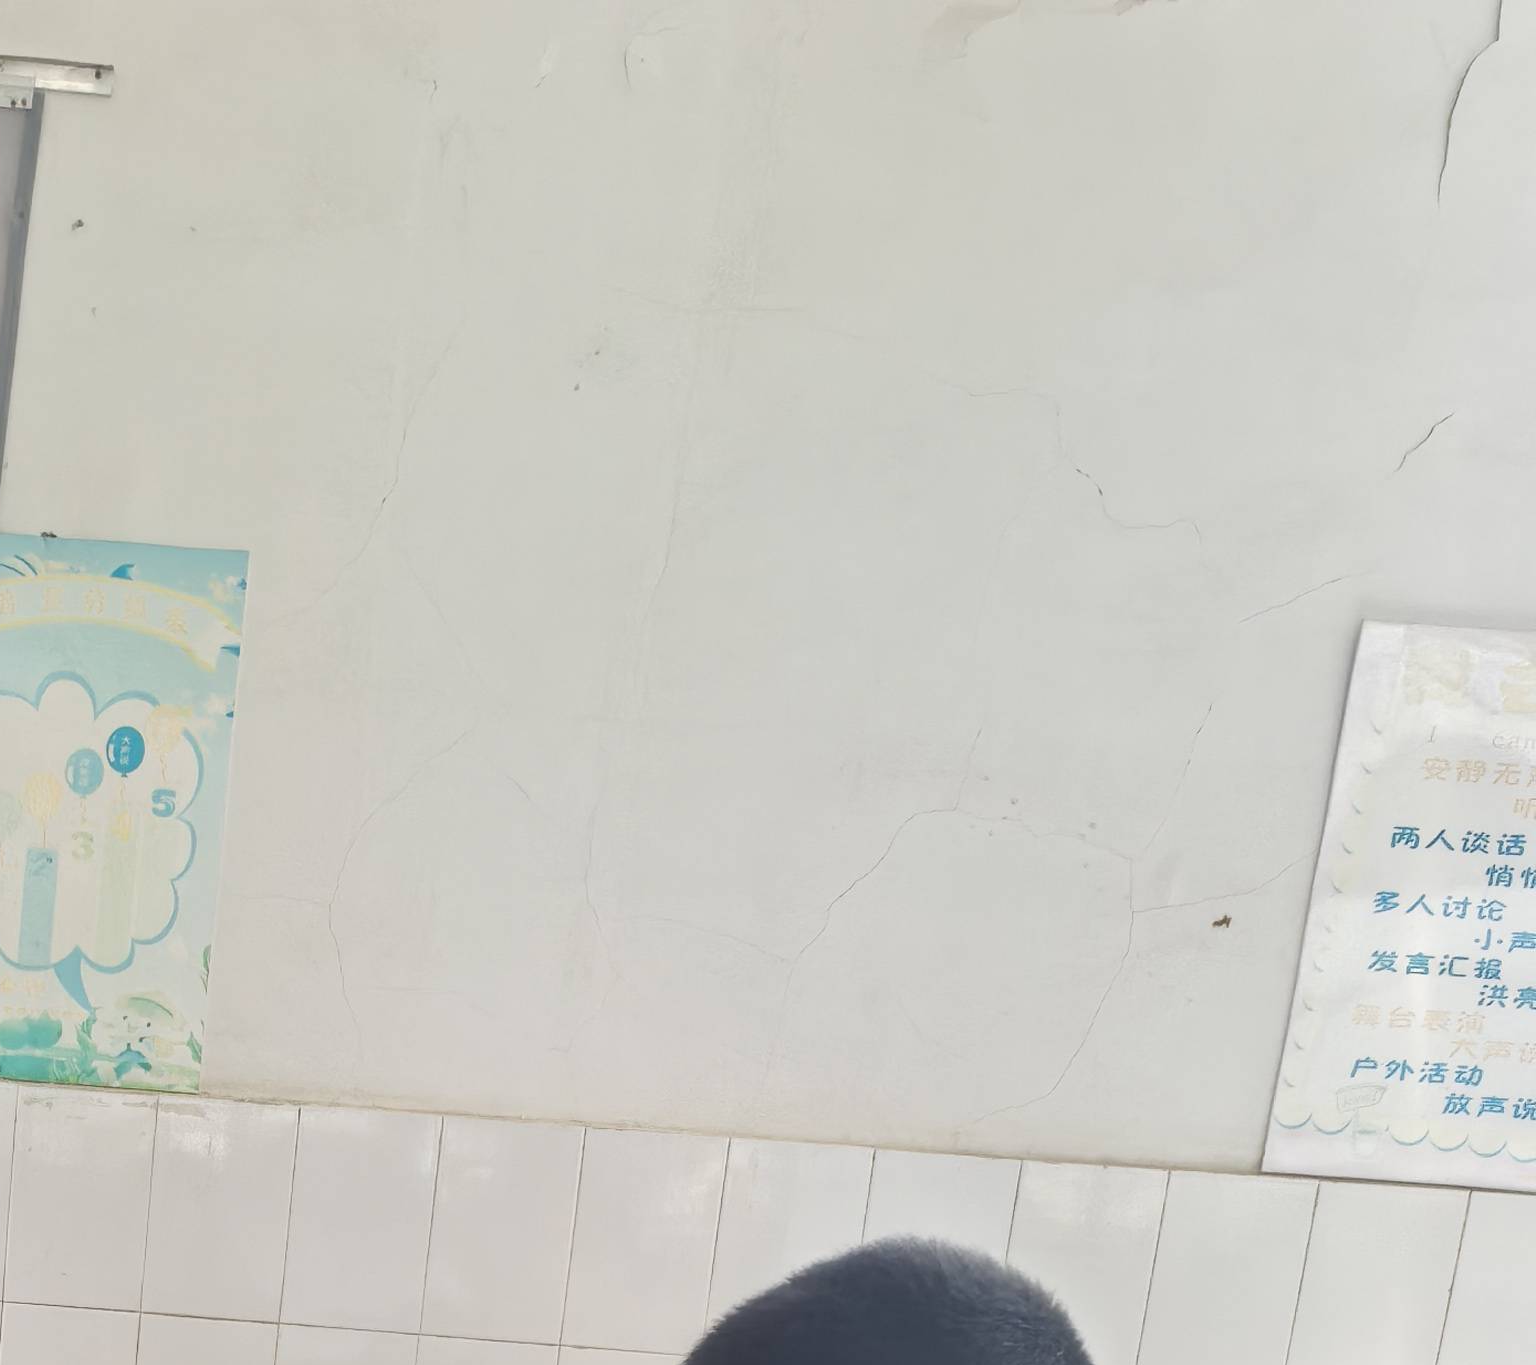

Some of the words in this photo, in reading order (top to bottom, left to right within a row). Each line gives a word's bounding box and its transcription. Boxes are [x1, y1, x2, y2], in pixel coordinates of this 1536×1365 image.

[151, 788, 177, 818] 5
[71, 831, 95, 860] 3
[1390, 825, 1528, 856] 两人谈话
[1373, 890, 1508, 922] 多人讨论
[1473, 927, 1536, 953] 小声
[1367, 950, 1504, 981] 发言汇报
[1477, 983, 1536, 1011] 洪亮
[1349, 1056, 1485, 1087] 户外活动
